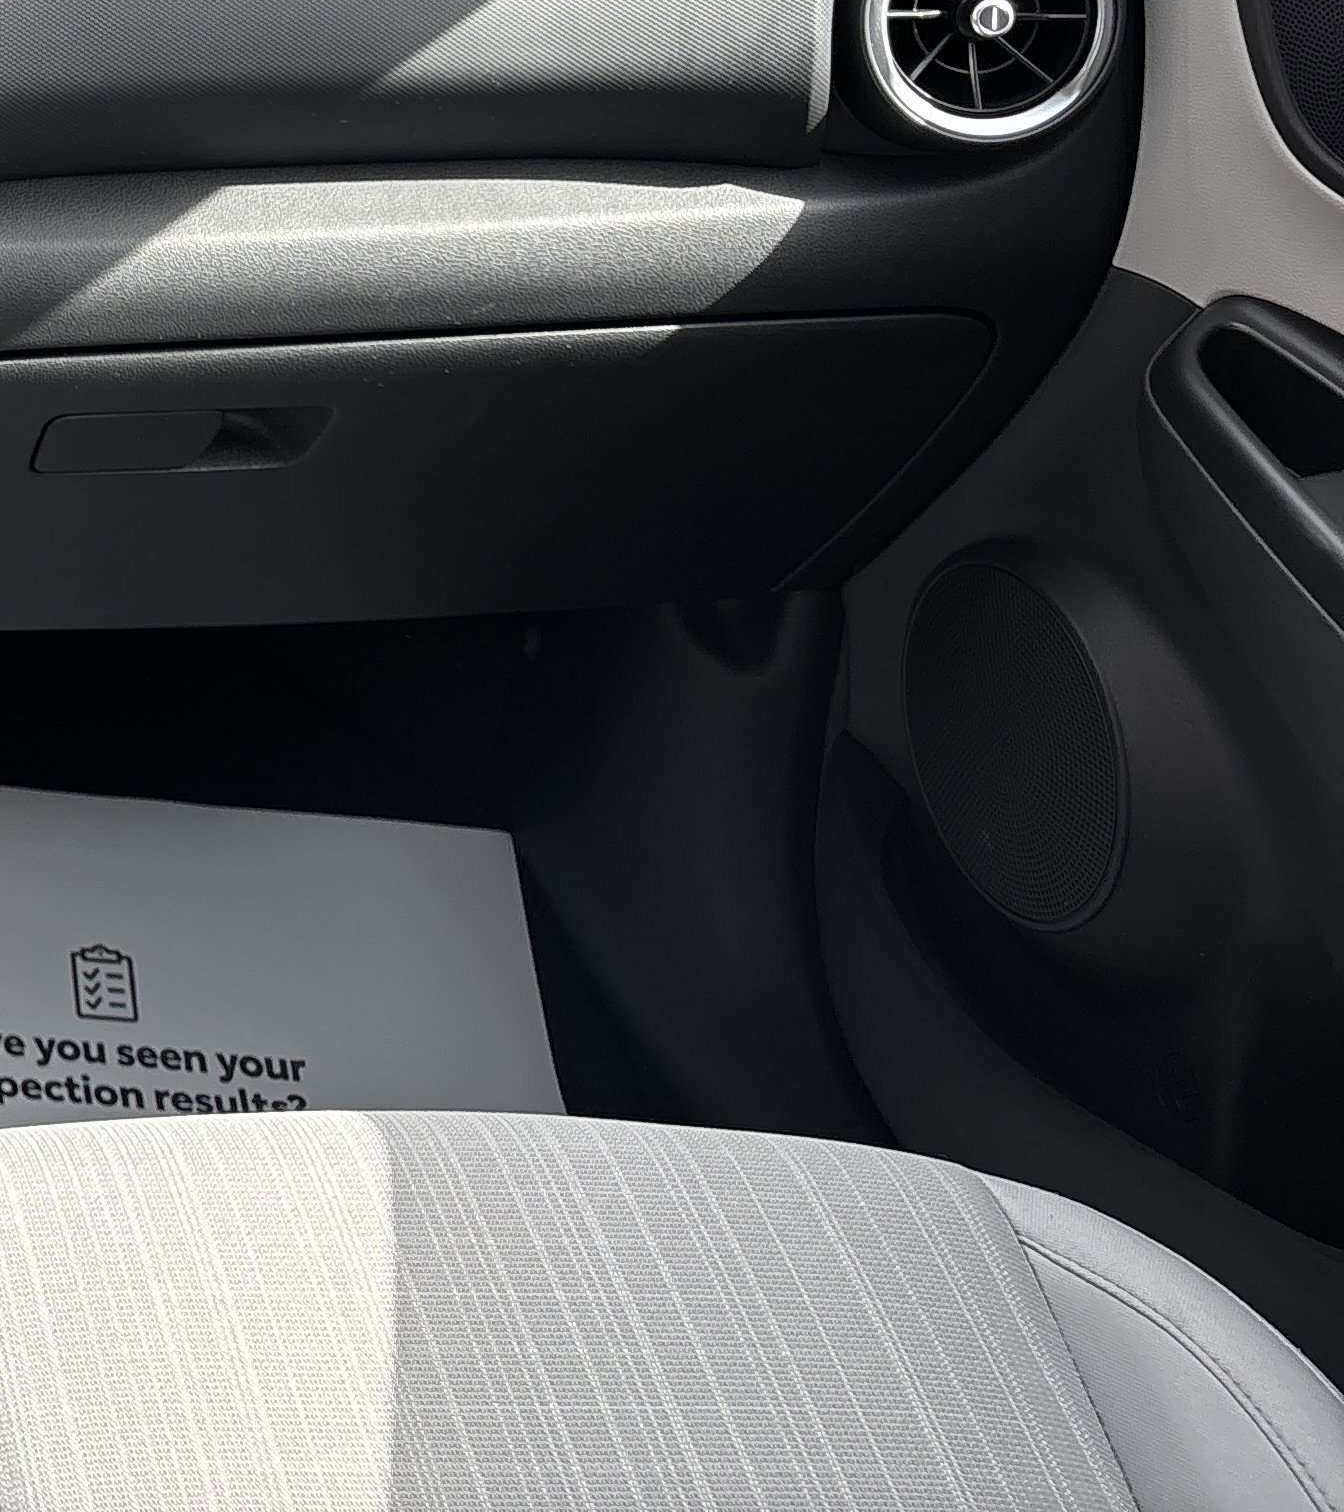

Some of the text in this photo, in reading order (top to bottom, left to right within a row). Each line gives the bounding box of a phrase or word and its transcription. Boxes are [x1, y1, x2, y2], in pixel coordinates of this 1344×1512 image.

[33, 1036, 107, 1067] you
[117, 1042, 208, 1074] seen
[216, 1051, 307, 1085] your
